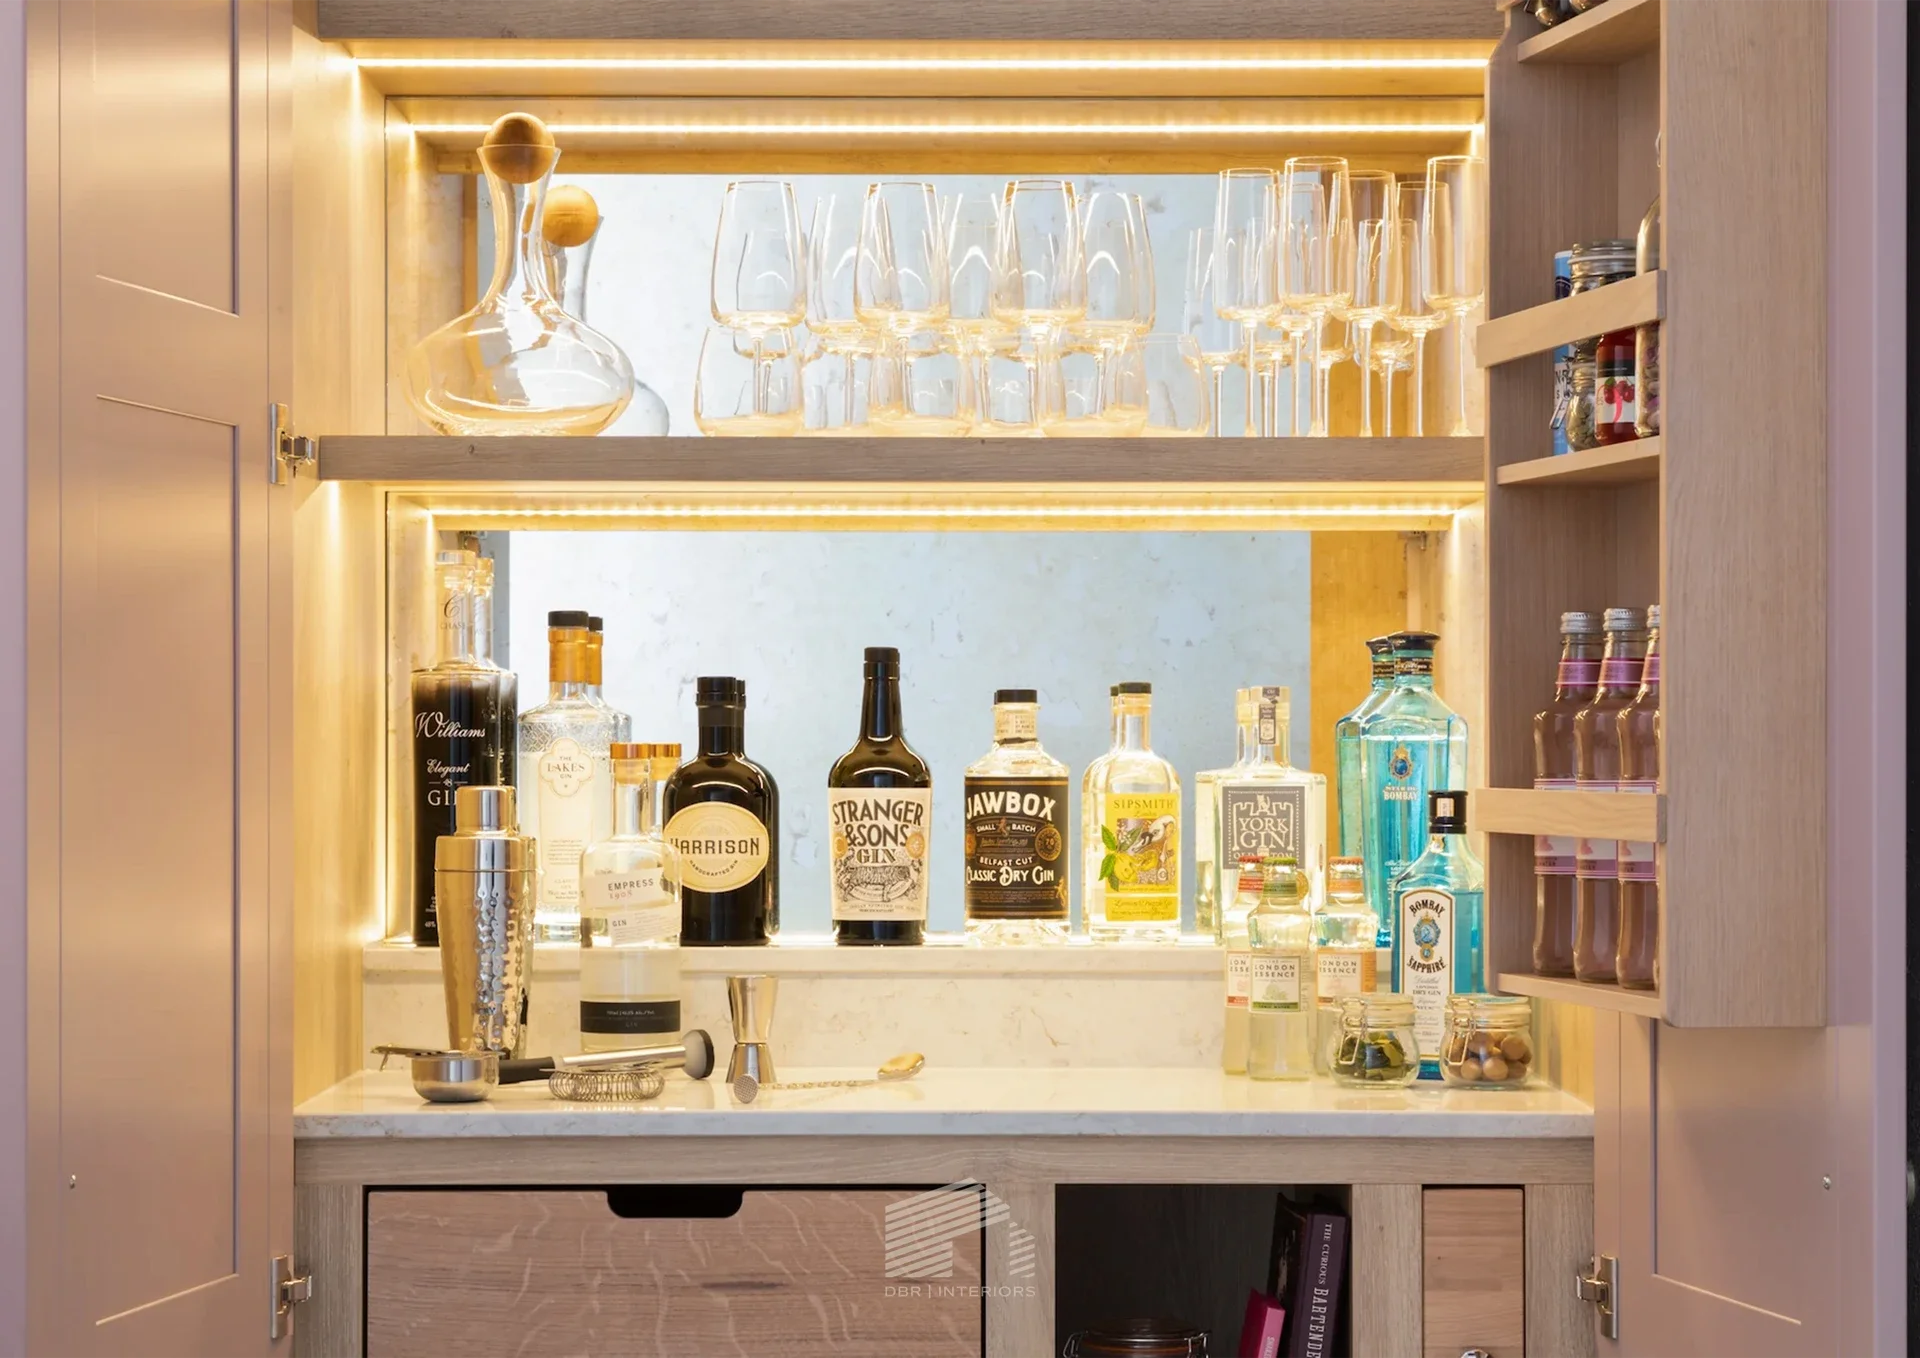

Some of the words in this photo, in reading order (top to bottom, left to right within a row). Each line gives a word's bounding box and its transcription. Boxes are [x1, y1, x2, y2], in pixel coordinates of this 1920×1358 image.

[415, 711, 486, 738] Williams
[426, 758, 470, 778] Elegant
[427, 789, 457, 806] GI
[1113, 799, 1173, 809] SIPSMITH
[1383, 791, 1418, 801] BOMBAY
[832, 799, 924, 826] STRANGER
[966, 791, 1056, 821] JAWBOX
[976, 823, 996, 833] SMALL
[1011, 823, 1036, 833] BATCH
[1238, 817, 1289, 833] YORK
[1240, 830, 1286, 849] GIN
[856, 848, 896, 864] GIN
[980, 856, 1012, 867] BELFAST
[1015, 856, 1033, 866] CUT
[608, 878, 654, 892] EMPRESS
[1409, 899, 1445, 917] BOMBAY
[612, 919, 627, 927] GIN
[1406, 955, 1448, 974] SAPPHIRE
[1323, 1223, 1333, 1242] THE
[1318, 1244, 1330, 1285] CURIOUS
